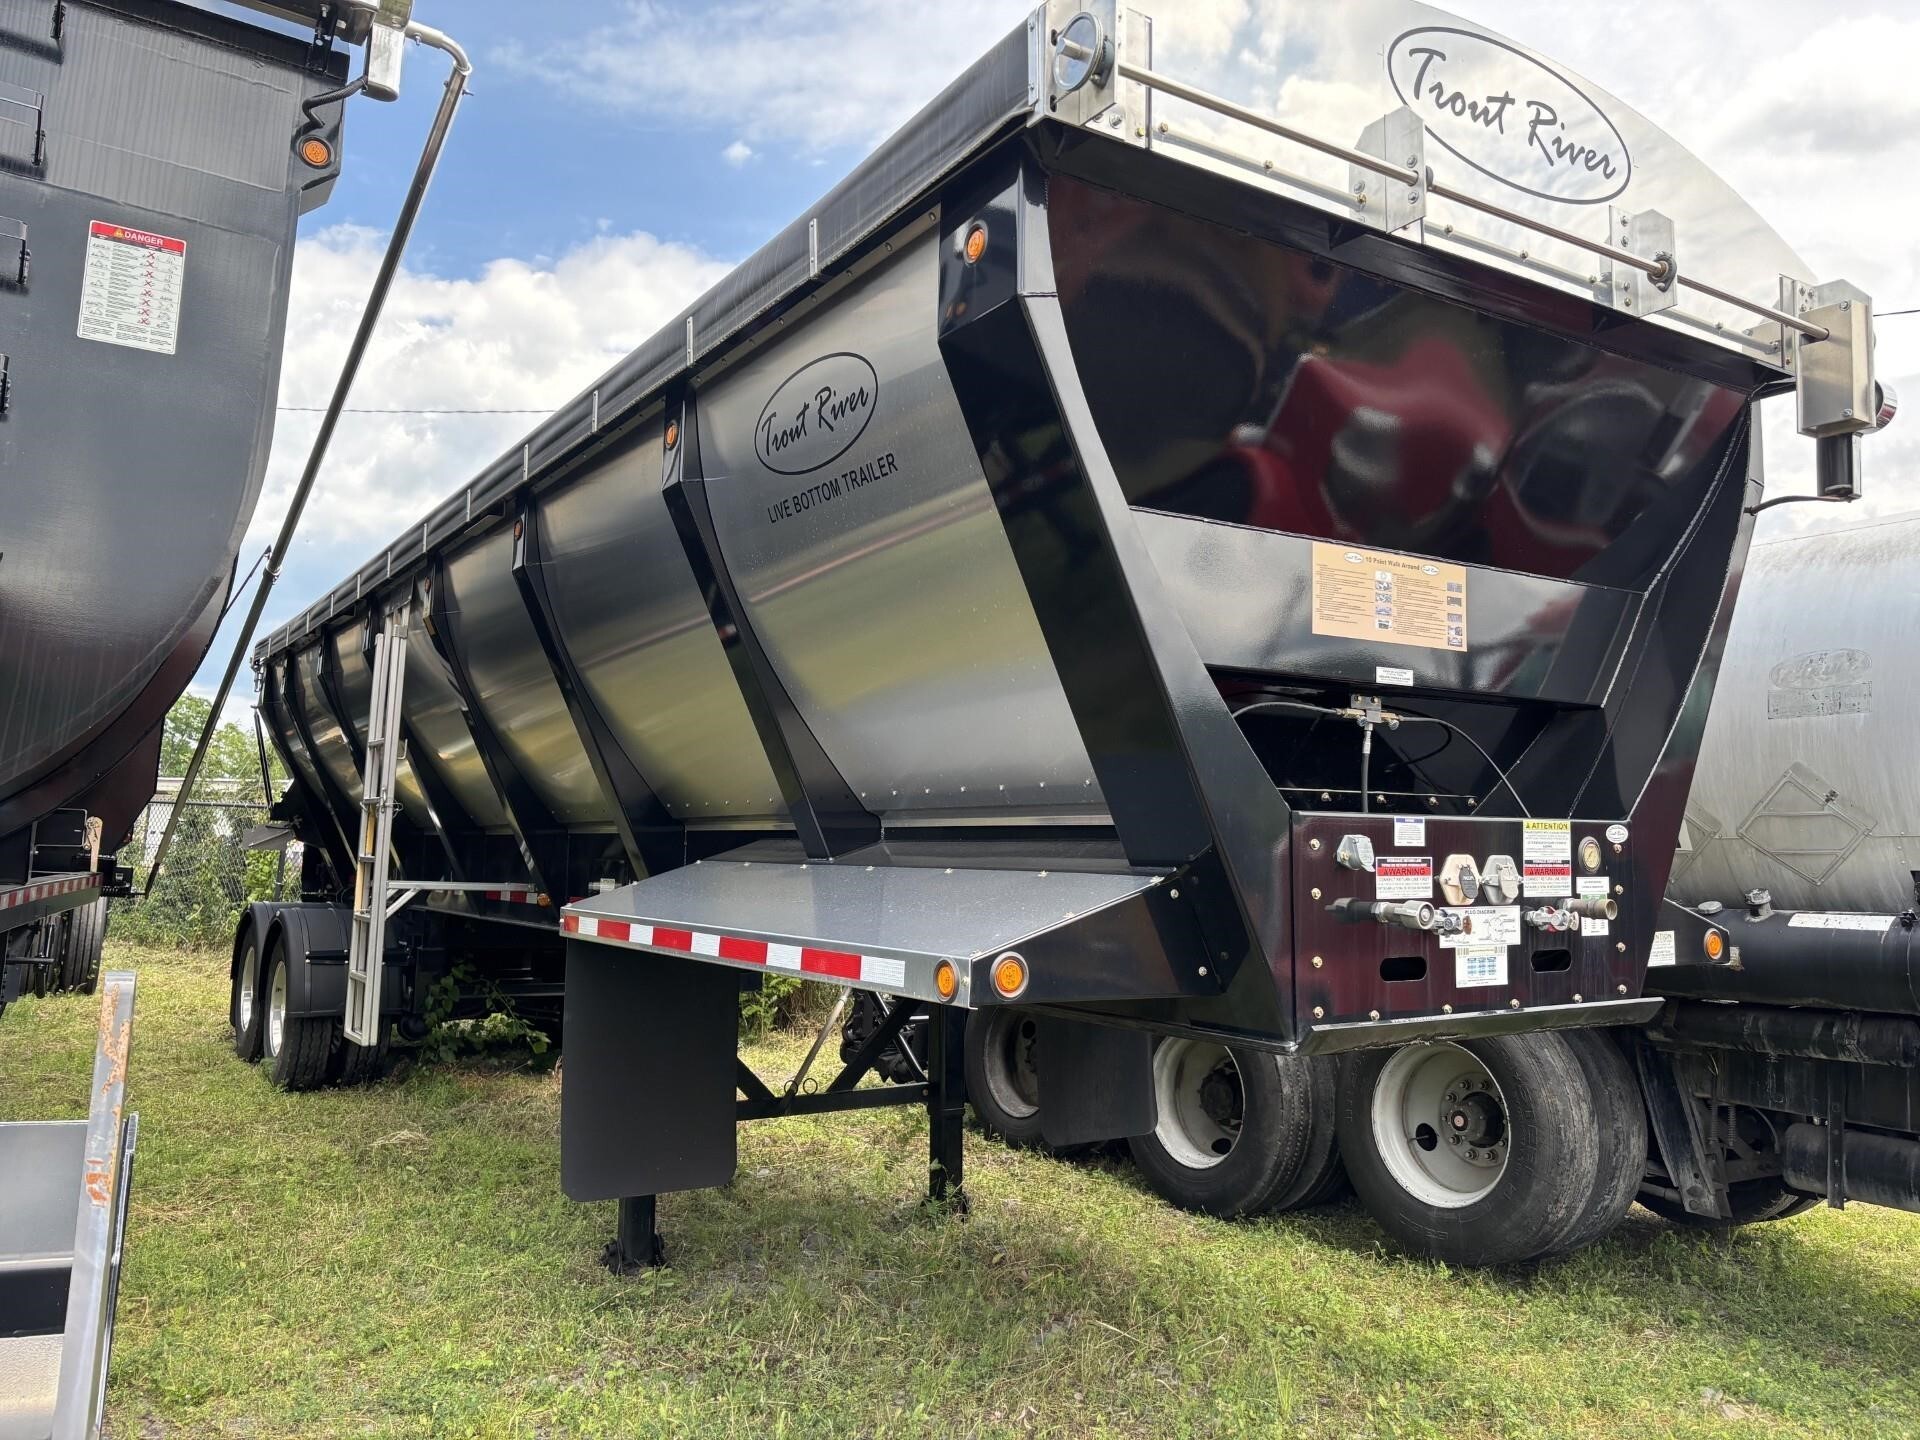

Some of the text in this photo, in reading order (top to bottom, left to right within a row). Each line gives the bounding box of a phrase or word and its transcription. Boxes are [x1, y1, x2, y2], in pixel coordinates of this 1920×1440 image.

[1408, 47, 1617, 180] Trout River
[124, 231, 164, 246] DANGER
[761, 386, 869, 457] Trout River
[767, 452, 899, 524] LIVE BOTTOM TRAILER
[1373, 557, 1387, 565] Point
[1388, 559, 1400, 567] Walk
[1401, 562, 1420, 571] Around
[1532, 822, 1568, 830] ATTENTION
[1389, 867, 1426, 876] WARNING
[1534, 868, 1566, 876] WARNING
[1655, 933, 1672, 942] NTION
